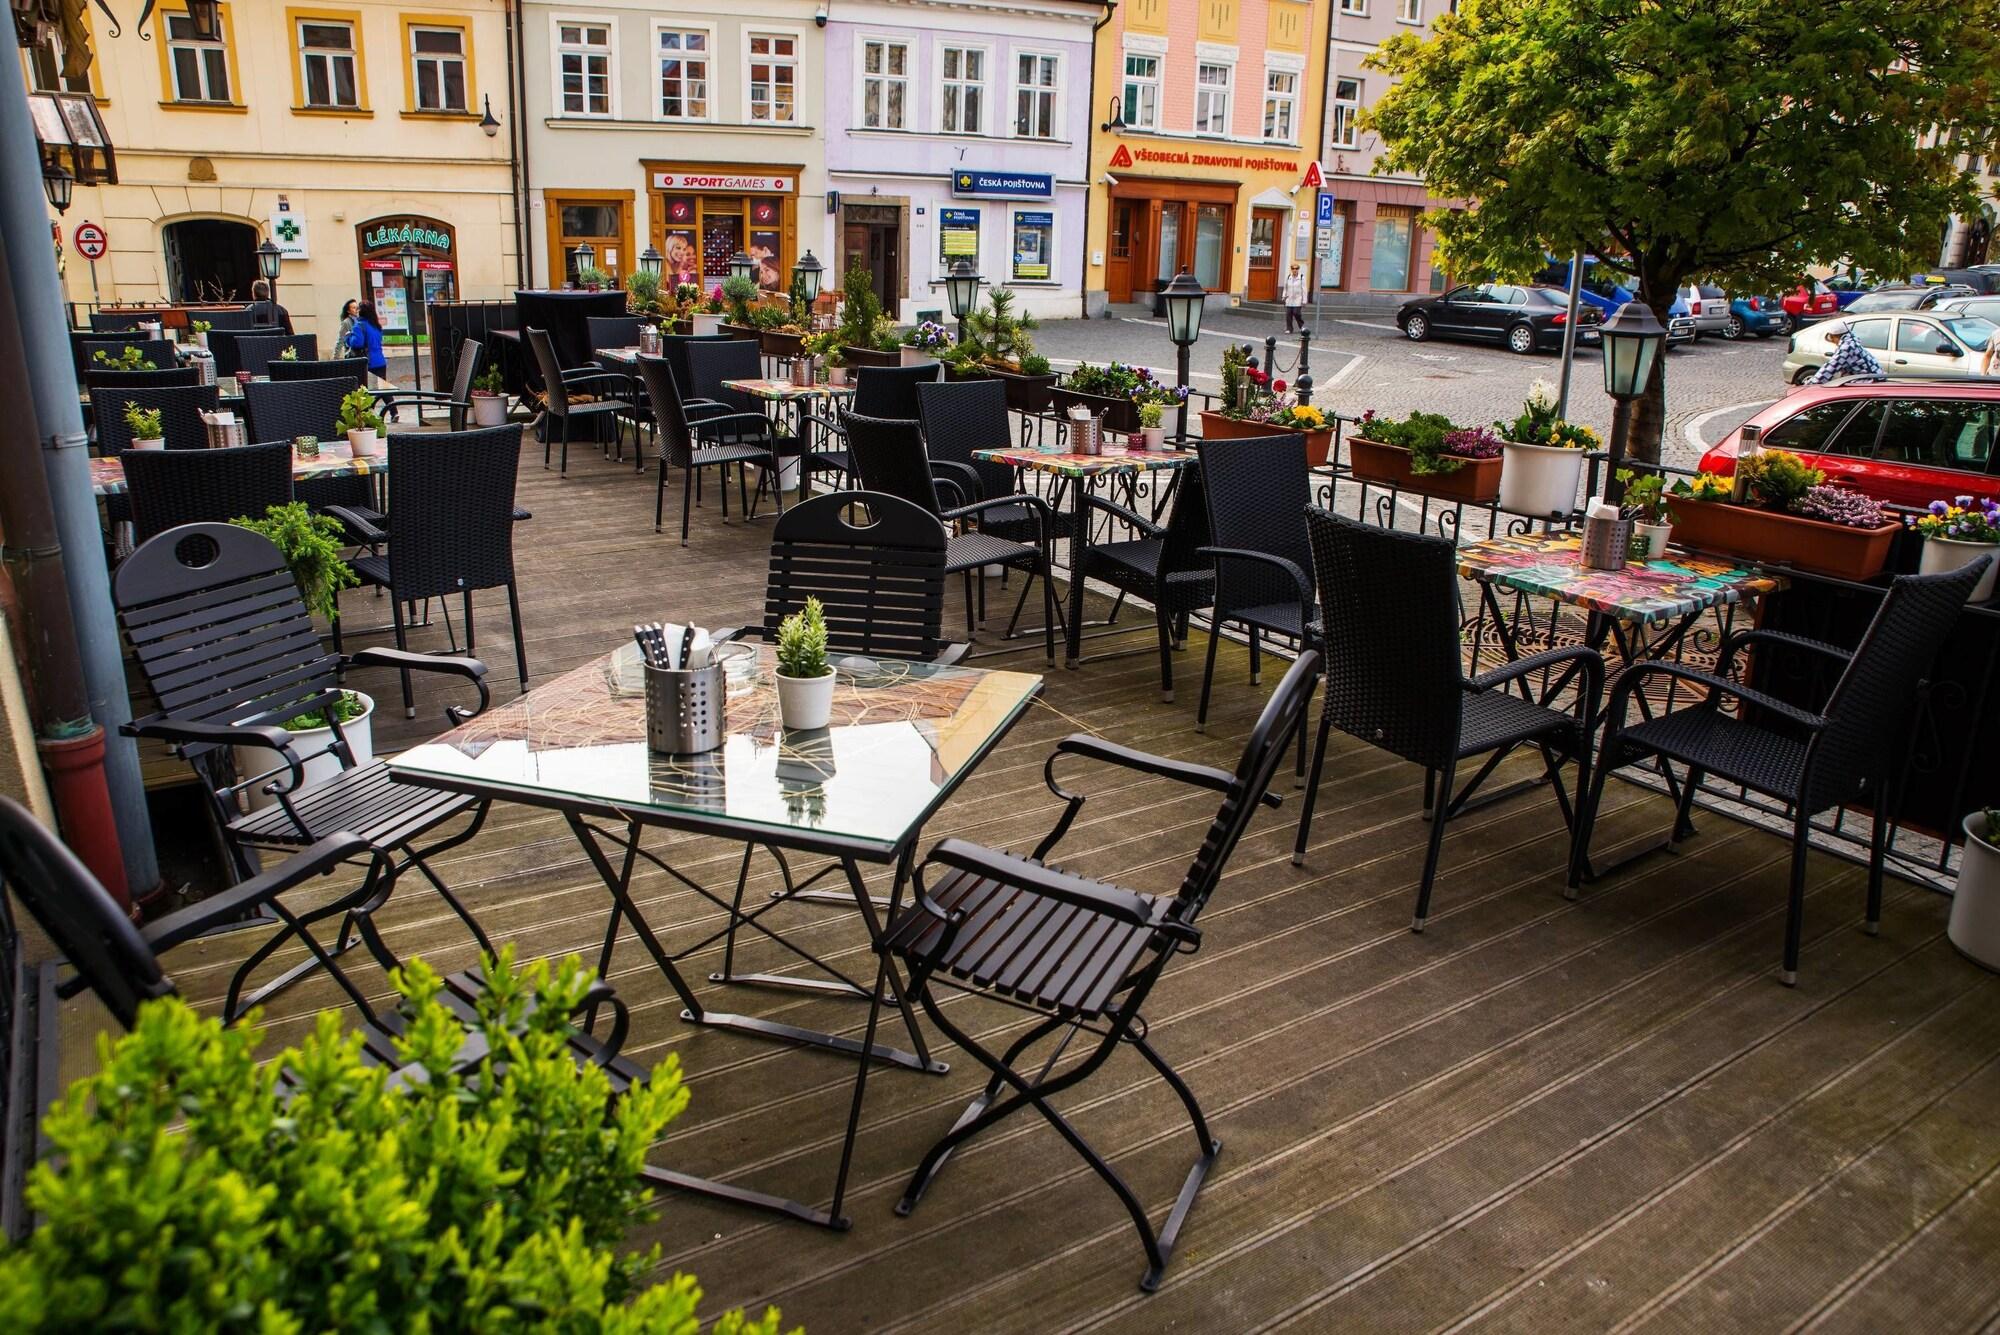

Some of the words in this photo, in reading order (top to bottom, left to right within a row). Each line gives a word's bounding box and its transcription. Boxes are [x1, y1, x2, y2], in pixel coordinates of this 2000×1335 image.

[1134, 148, 1189, 164] VŠEOBECNÁ
[1191, 154, 1243, 169] ZDRAVOTNÍ
[1245, 158, 1298, 172] POJIŠŤOVNA
[683, 176, 765, 189] SPORTGAMES
[979, 177, 1002, 188] ČESKÁ
[1003, 179, 1046, 190] POJIŠŤOVNA
[1322, 196, 1331, 217] P
[367, 224, 449, 248] LÉKÁRNA
